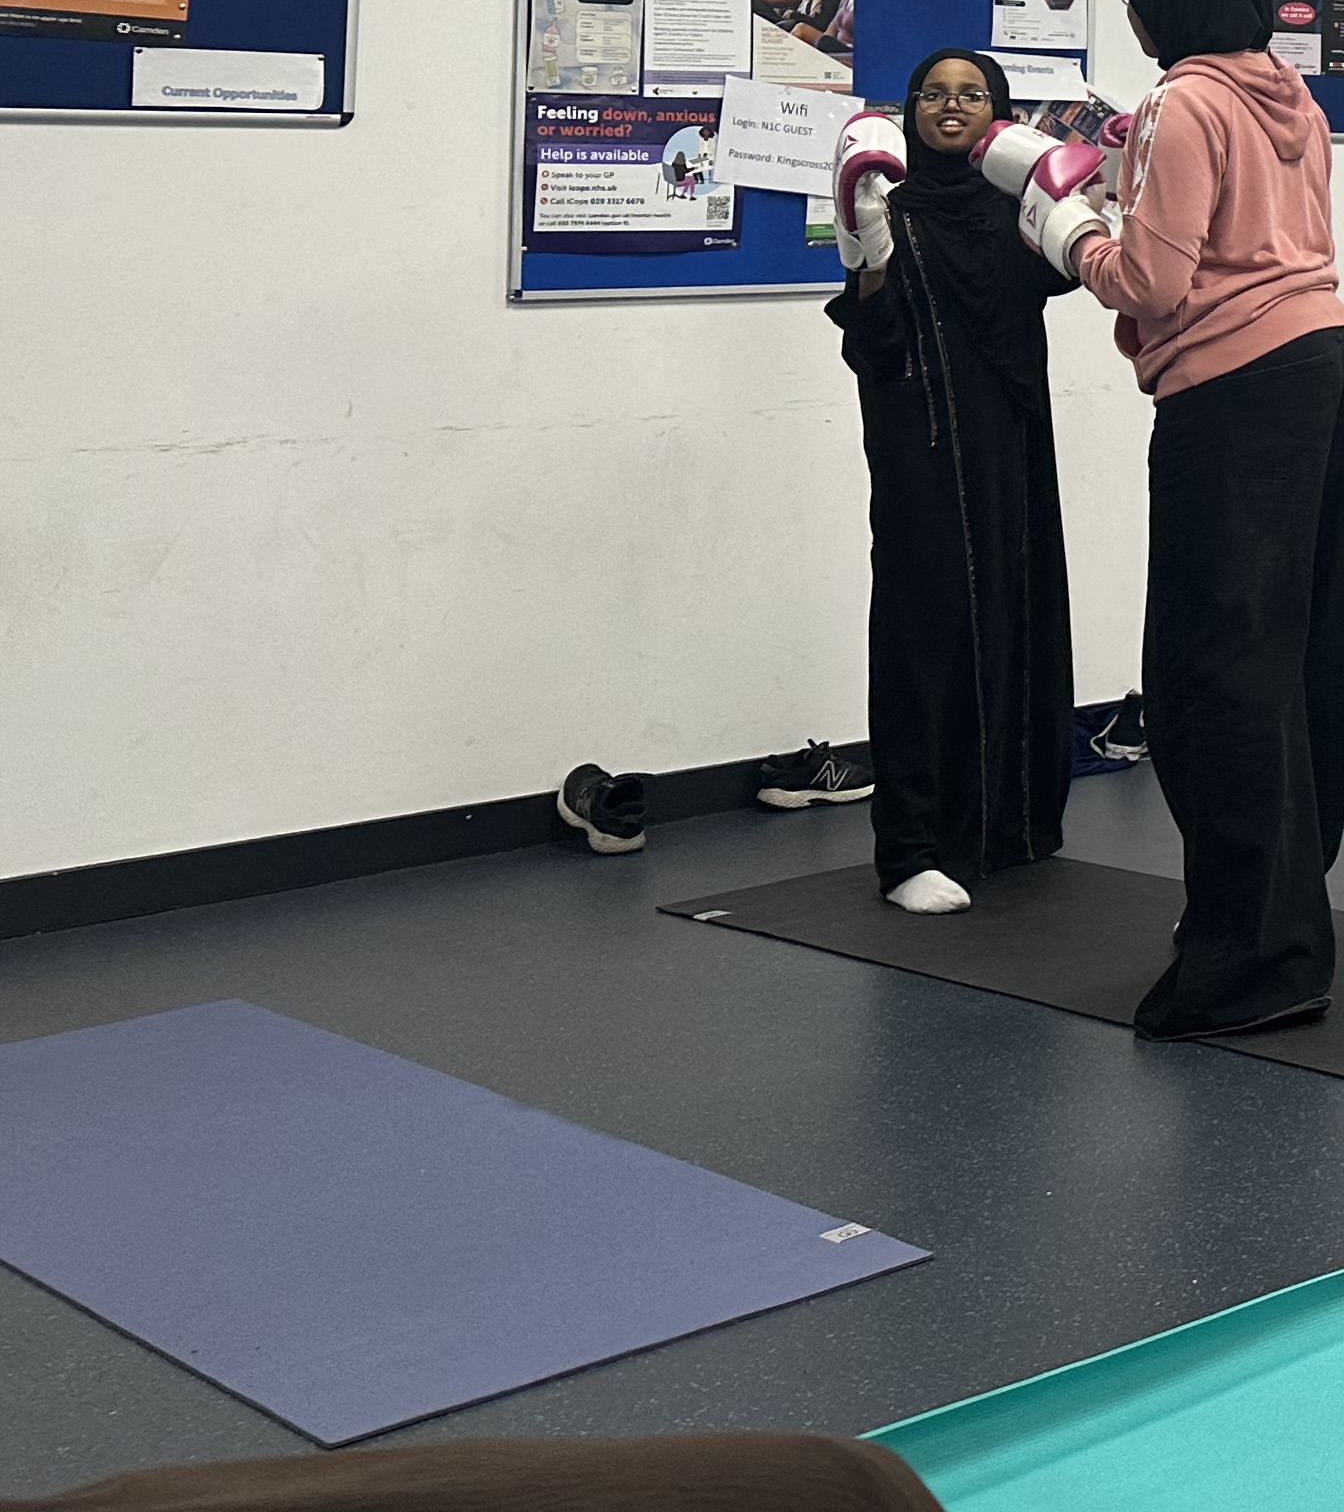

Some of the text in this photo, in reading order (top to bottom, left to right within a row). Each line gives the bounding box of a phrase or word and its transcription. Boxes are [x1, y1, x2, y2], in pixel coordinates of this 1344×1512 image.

[162, 86, 298, 101] Current Opportunities
[538, 105, 716, 123] Feeling down, anxious
[781, 101, 808, 117] Wifi
[537, 124, 632, 137] or worried?
[732, 117, 814, 136] Login: N1C GUEST
[540, 148, 649, 161] Help is available
[729, 148, 775, 163] Password:
[567, 198, 588, 206] iCope
